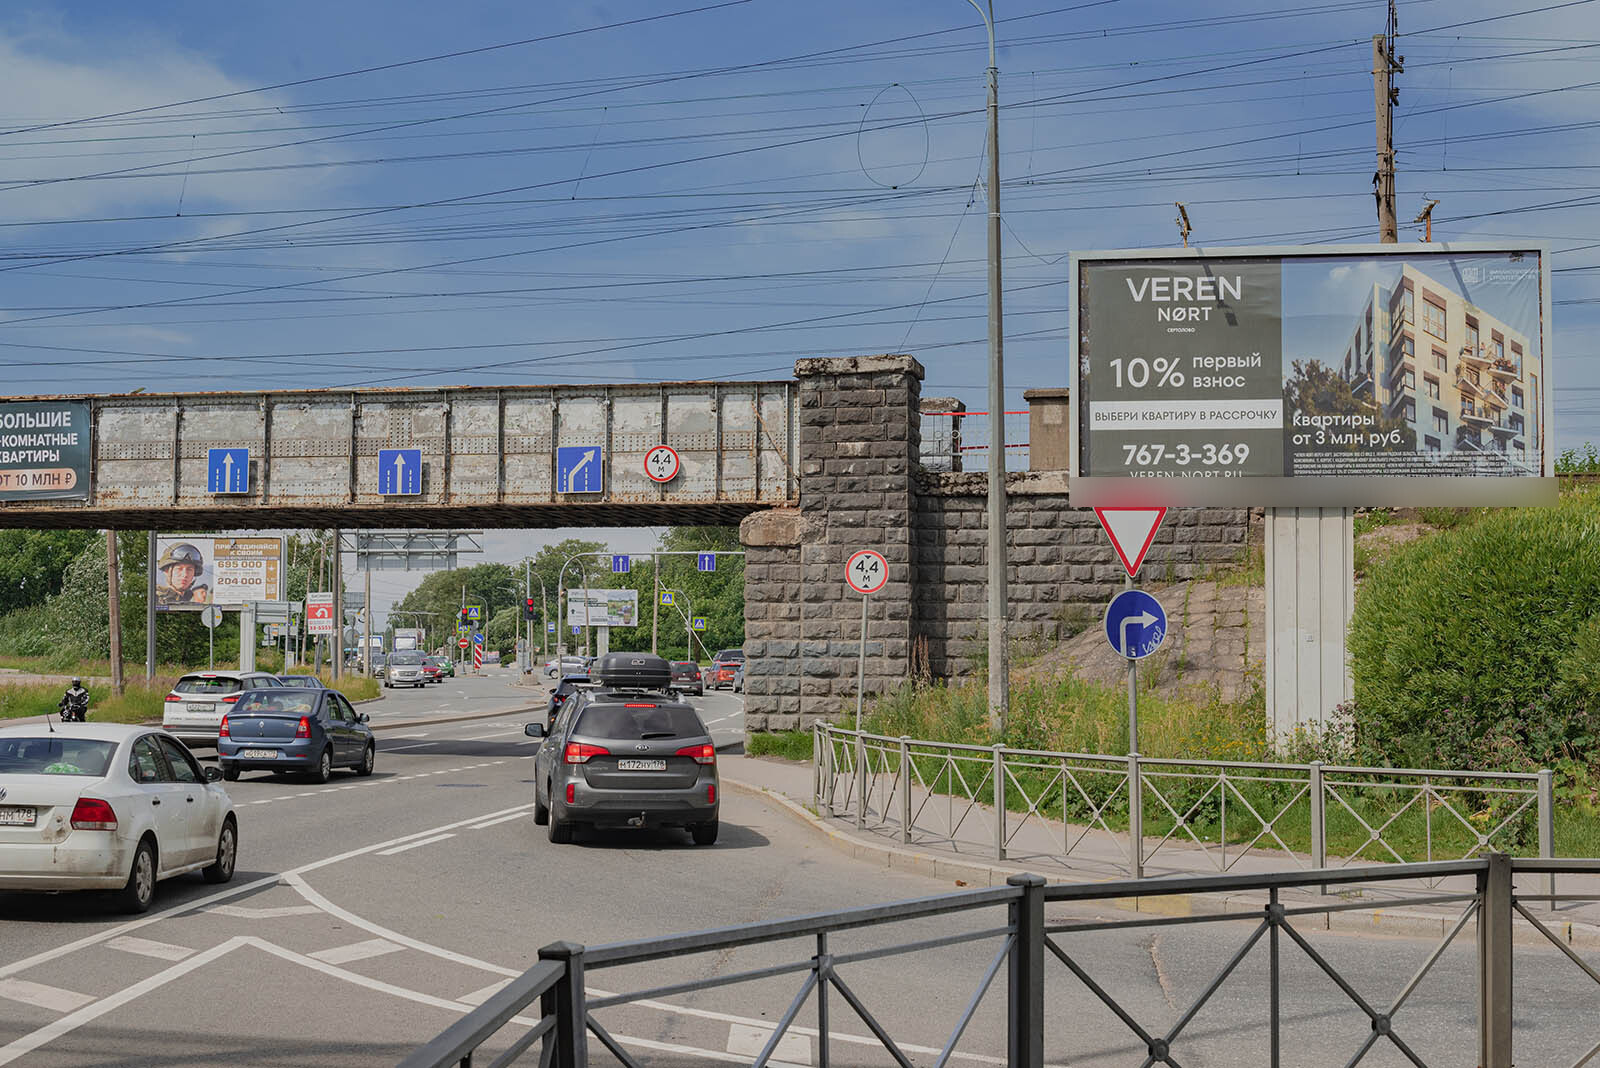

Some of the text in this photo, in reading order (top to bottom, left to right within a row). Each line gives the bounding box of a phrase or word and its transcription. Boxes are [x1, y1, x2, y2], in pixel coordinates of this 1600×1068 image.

[1126, 276, 1242, 302] VEREN
[1193, 352, 1262, 372] первый
[1110, 357, 1185, 388] 10%
[1193, 376, 1246, 388] взнос
[1095, 410, 1277, 422] ВЫБЕРИ КВАРТИРУ В РАССРОЧКУ
[1293, 415, 1375, 429] квартиры
[1293, 429, 1405, 447] от 3 млн руб.
[0, 450, 60, 463] ВАРТИРЫ
[1123, 443, 1250, 466] 767-3-369
[15, 474, 28, 486] 10
[32, 473, 61, 486] МЛН
